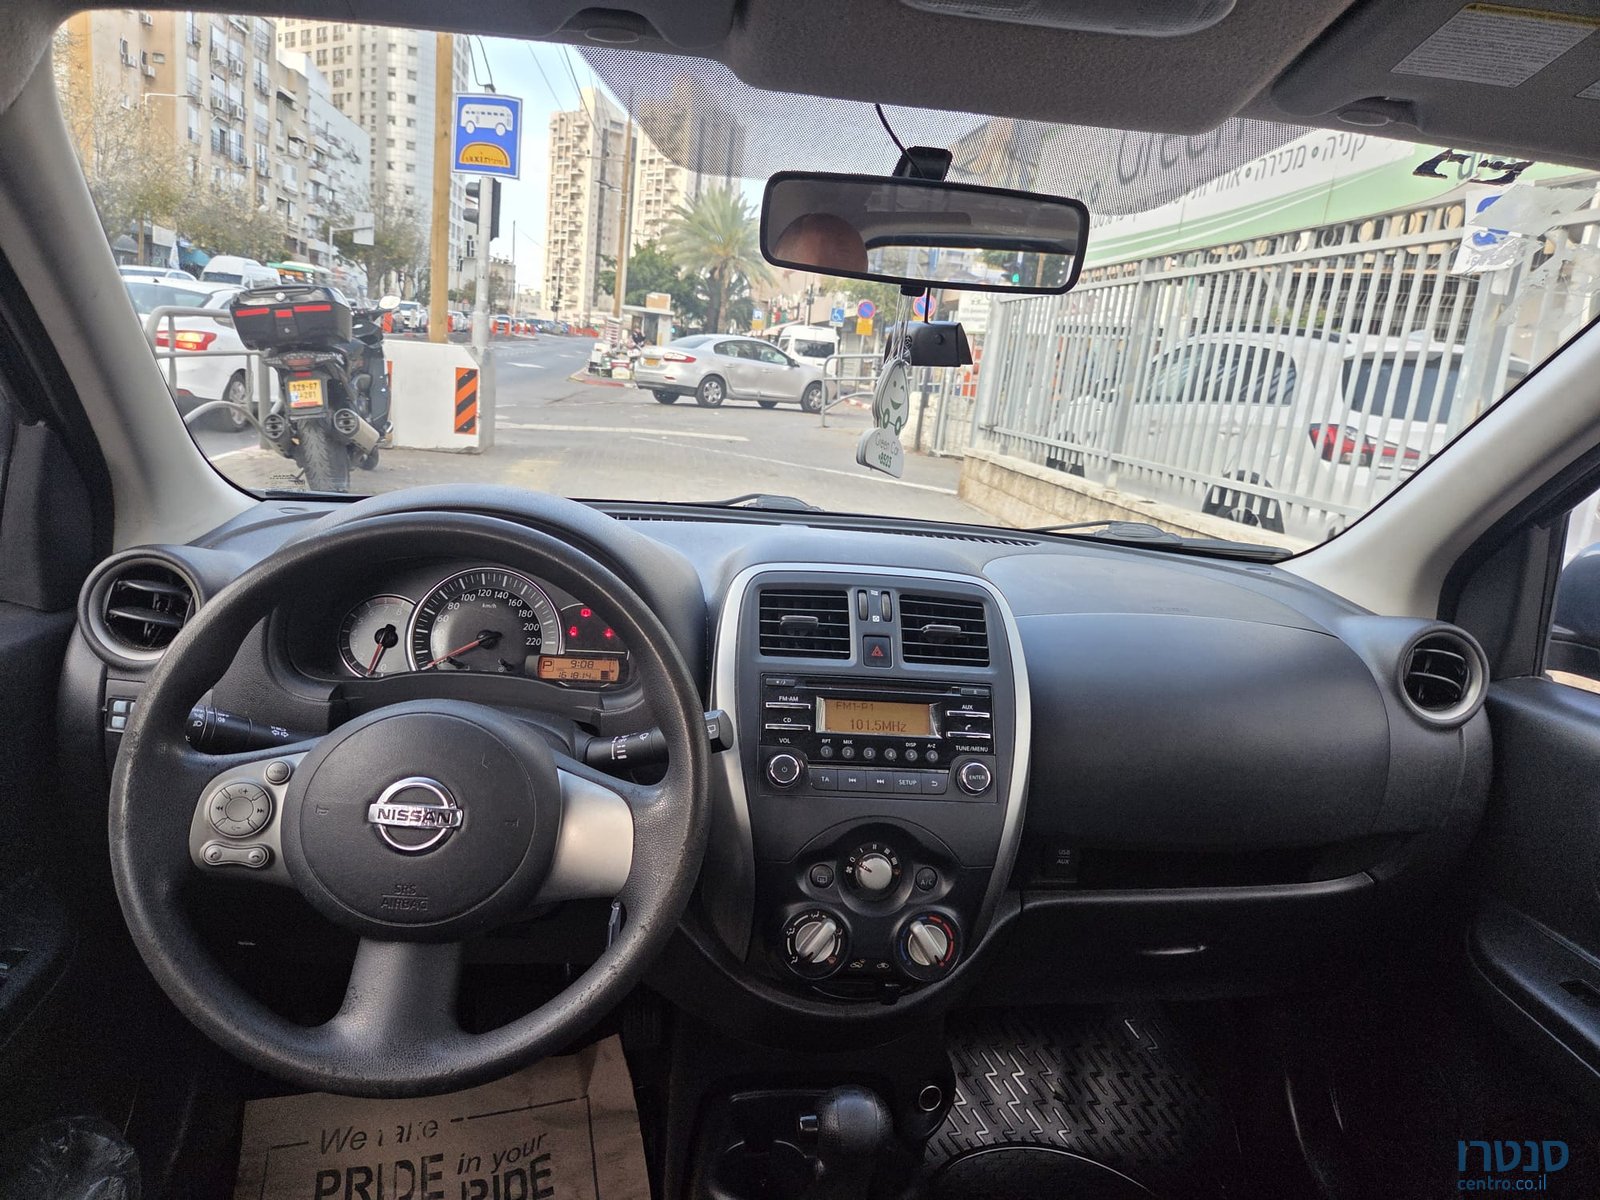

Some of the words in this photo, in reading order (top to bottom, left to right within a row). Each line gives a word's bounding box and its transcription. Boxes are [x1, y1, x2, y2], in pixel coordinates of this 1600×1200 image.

[1254, 144, 1307, 182] מכירה
[460, 593, 476, 602] 100
[477, 589, 492, 597] 120
[494, 591, 509, 599] 140
[447, 602, 460, 610] 80
[508, 599, 523, 607] 160
[518, 609, 533, 618] 180
[437, 614, 450, 623] 60
[522, 622, 540, 631] 200
[525, 637, 542, 646] 220
[542, 660, 553, 670] P
[570, 659, 595, 669] 9:08
[849, 718, 908, 733] 101.5MHz
[955, 745, 989, 753] TUNE/MENU
[899, 779, 918, 787] SETUP
[377, 807, 452, 824] NISSAN
[381, 898, 429, 912] AIRBAG
[321, 1126, 368, 1155] We
[457, 1152, 481, 1175] in
[490, 1132, 549, 1175] your
